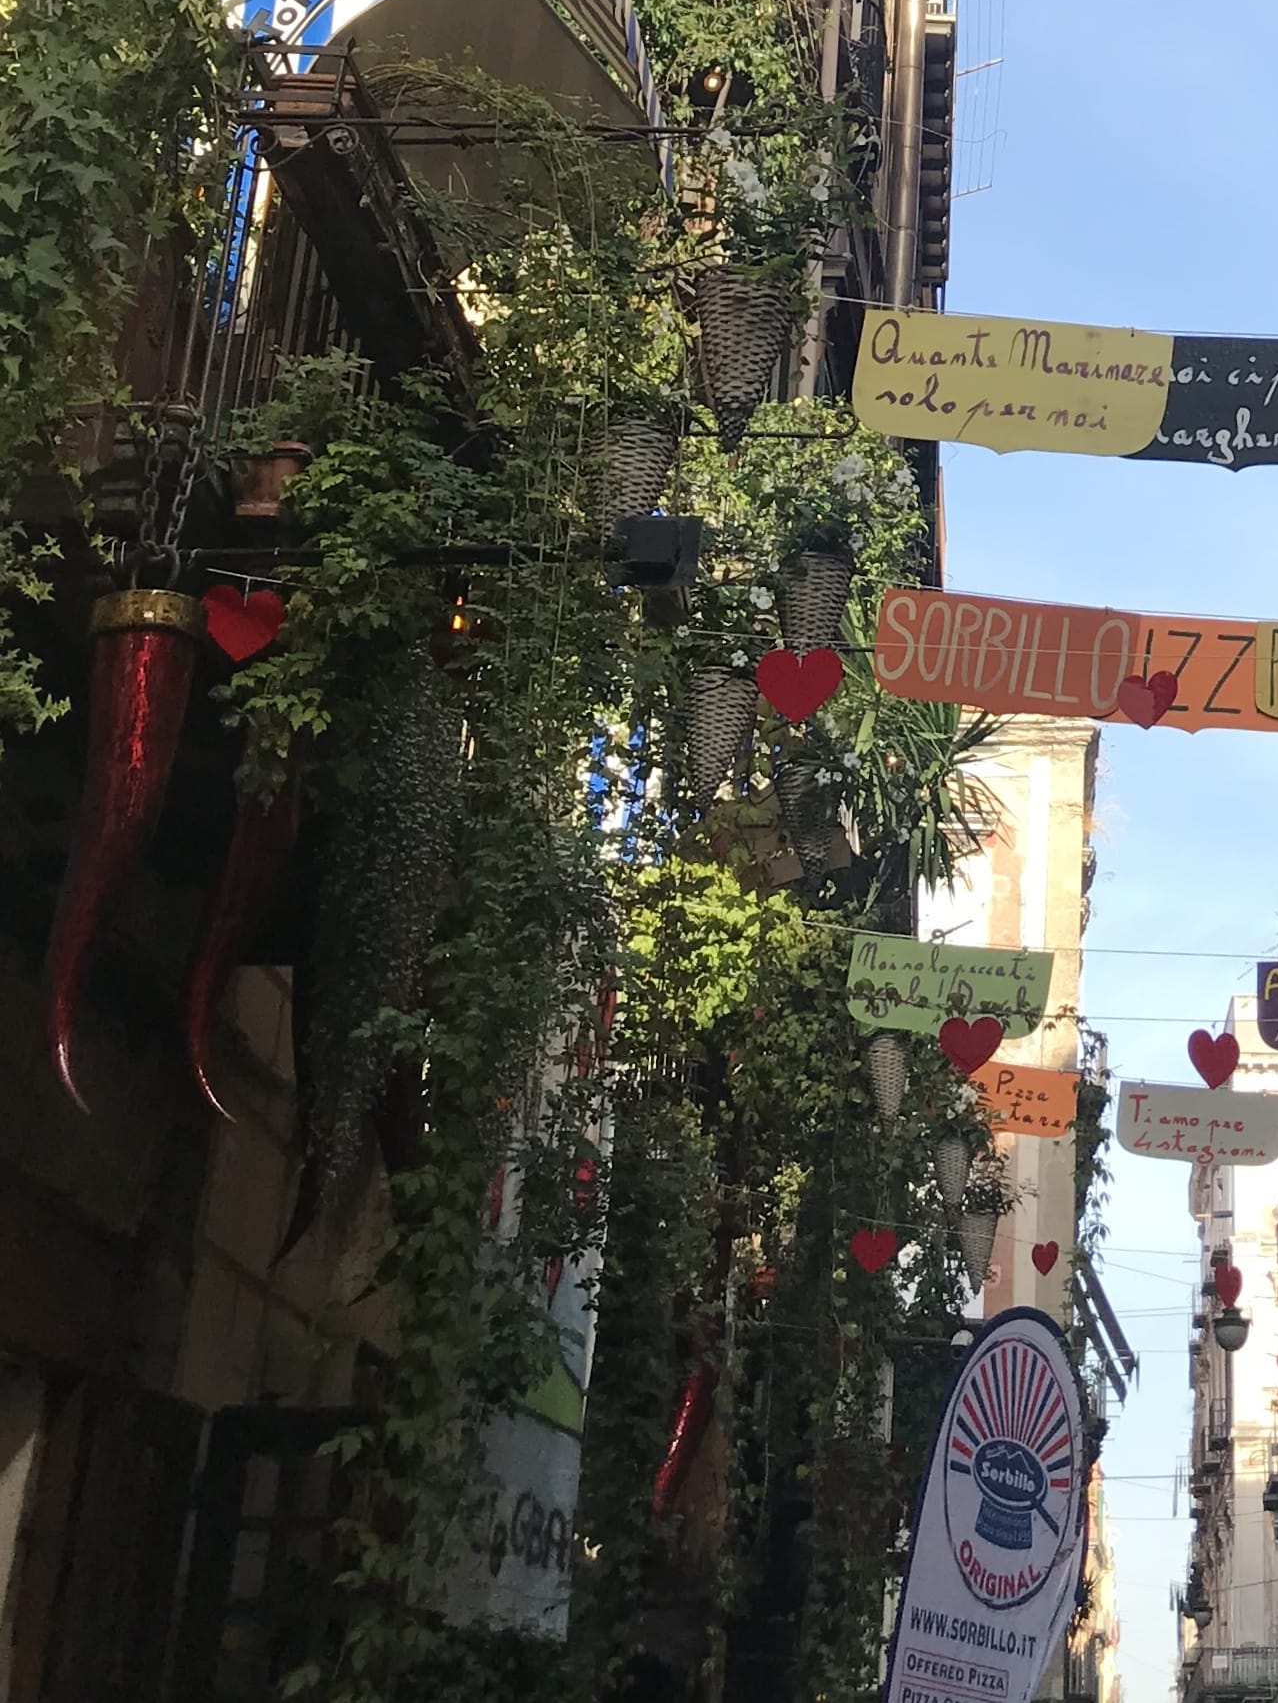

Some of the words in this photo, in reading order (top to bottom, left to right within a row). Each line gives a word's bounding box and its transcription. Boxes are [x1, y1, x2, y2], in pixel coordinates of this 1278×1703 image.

[871, 318, 998, 368] Quante
[1008, 327, 1166, 387] Marinare
[1227, 356, 1263, 385] ci
[875, 371, 957, 414] solo
[955, 397, 1036, 439] per
[1046, 404, 1108, 430] noi
[876, 596, 1131, 711] SORBILLO
[1141, 627, 1257, 715] IZZ
[995, 1068, 1050, 1102] Pizza
[1129, 1094, 1153, 1123] Ti
[1159, 1115, 1199, 1127] amo
[981, 1461, 1036, 1493] Sorbillo
[960, 1539, 1041, 1600] ORIGINAL
[910, 1606, 1037, 1659] WWW.SORBILLO.IT
[907, 1653, 964, 1681] OFFERED
[968, 1667, 1005, 1691] PIZZA
